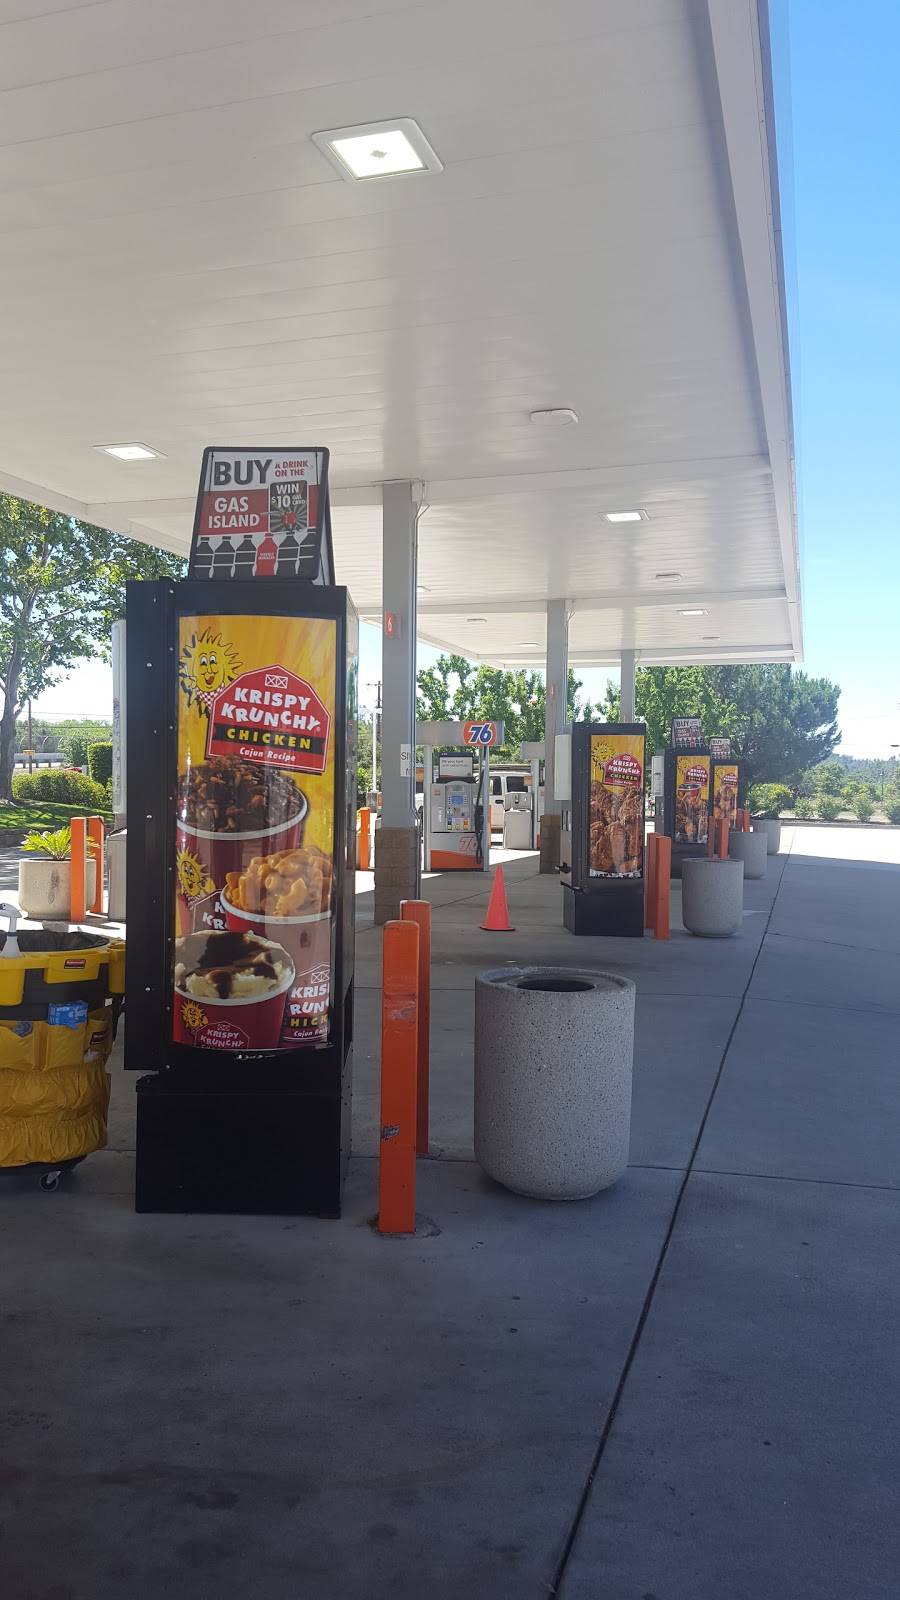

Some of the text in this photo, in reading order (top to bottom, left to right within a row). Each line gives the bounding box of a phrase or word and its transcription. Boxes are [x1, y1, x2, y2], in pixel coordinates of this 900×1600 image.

[282, 460, 309, 469] DRINK
[289, 468, 305, 476] THE
[213, 459, 272, 486] BUY
[276, 483, 300, 494] WIN
[214, 496, 249, 513] GAS
[271, 494, 291, 508] $10
[208, 514, 261, 529] ISLAND
[387, 617, 393, 632] 6
[234, 687, 312, 711] KRISPY
[221, 702, 321, 732] KRUNCHY
[226, 728, 312, 750] CHICKEN
[468, 723, 493, 744] 76
[239, 746, 297, 762] Cajun Recipe
[608, 765, 641, 775] KRUNCHY
[613, 759, 638, 768] KRISPY
[200, 1035, 245, 1047] KRUNCHY
[207, 1029, 239, 1039] KRISPY
